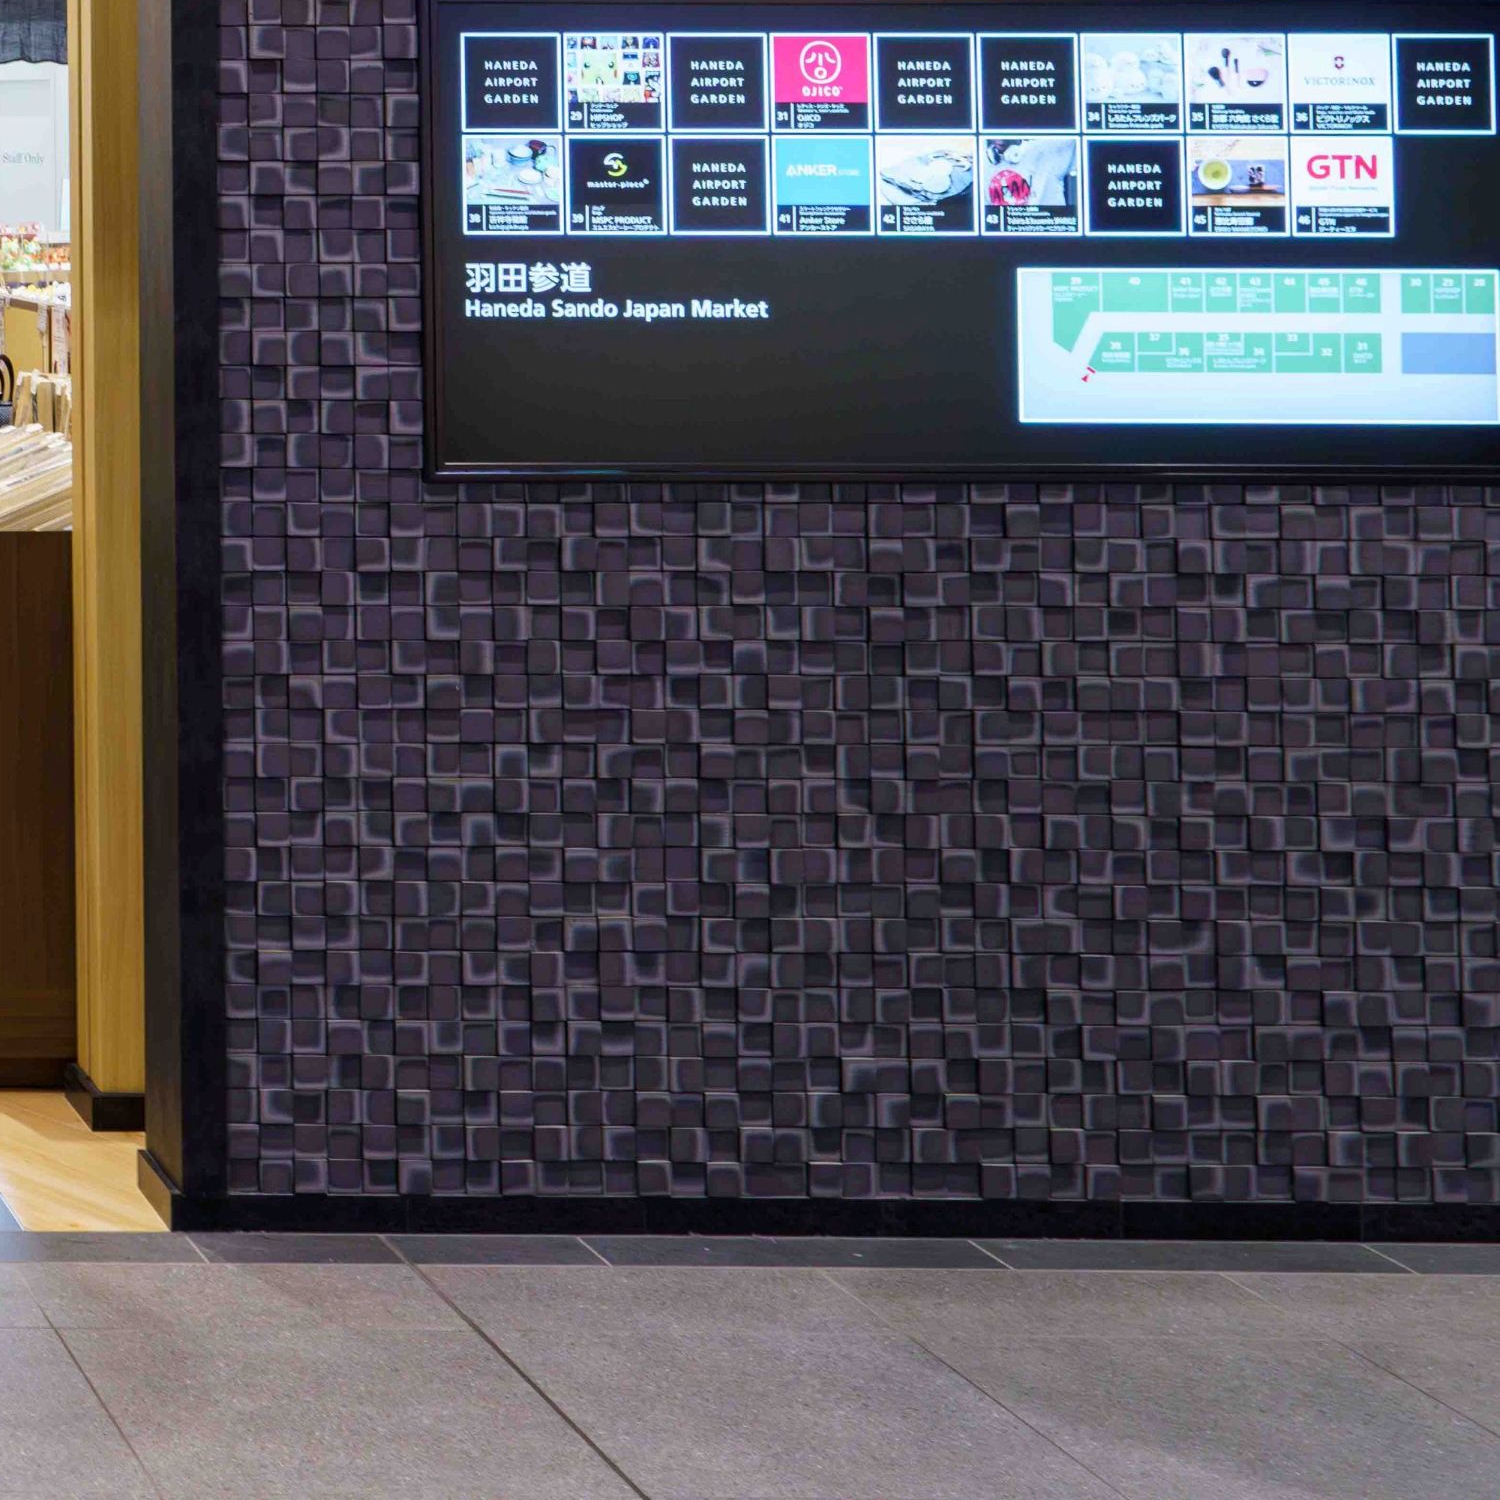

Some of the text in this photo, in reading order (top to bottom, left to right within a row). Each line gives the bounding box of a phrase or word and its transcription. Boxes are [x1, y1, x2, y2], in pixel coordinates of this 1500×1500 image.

[484, 61, 538, 70] HANEDA
[691, 61, 745, 70] HANEDA
[898, 61, 952, 70] HANEDA
[1001, 61, 1056, 70] HANEDA
[1417, 62, 1471, 71] HANEDA
[484, 77, 538, 87] AIRPORT
[691, 77, 745, 87] AIRPORT
[898, 77, 952, 87] AIRPORT
[1001, 78, 1056, 87] AIRPORT
[1304, 76, 1375, 86] VICTORINOX
[1417, 79, 1471, 88] AIRPORT
[802, 85, 841, 97] OJICO
[484, 94, 538, 103] GARDEN
[691, 94, 745, 103] GARDEN
[898, 94, 952, 103] GARDEN
[1001, 95, 1056, 104] GARDEN
[1417, 96, 1471, 105] GARDEN
[570, 110, 582, 121] 29
[776, 111, 788, 121] 31
[796, 114, 822, 122] OJICO
[1191, 111, 1204, 122] 35
[692, 163, 747, 172] HANEDA
[786, 163, 837, 177] ANKER
[1108, 164, 1162, 173] HANEDA
[1307, 154, 1378, 180] GTN
[692, 180, 747, 189] AIRPORT
[1108, 181, 1162, 190] AIRPORT
[692, 197, 747, 206] GARDEN
[1108, 198, 1162, 207] GARDEN
[779, 213, 791, 224] 41
[799, 216, 846, 225] Anker Store
[882, 213, 896, 224] 42
[1318, 217, 1337, 226] GTN
[465, 262, 592, 292] 羽田参道
[465, 298, 769, 322] Haneda Sando Japan Market
